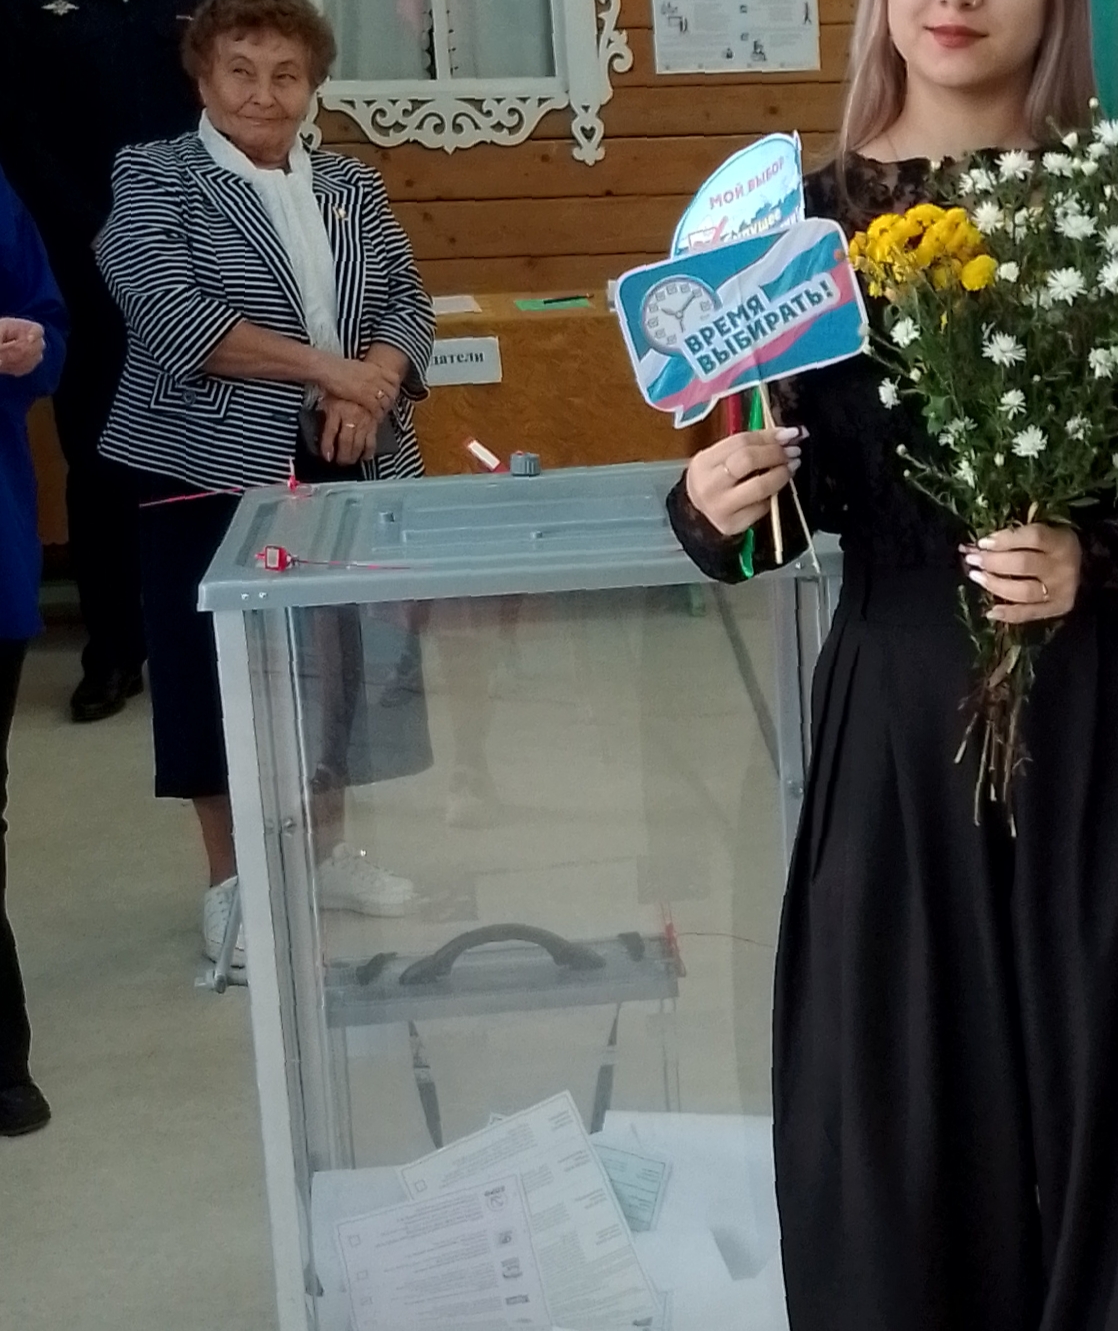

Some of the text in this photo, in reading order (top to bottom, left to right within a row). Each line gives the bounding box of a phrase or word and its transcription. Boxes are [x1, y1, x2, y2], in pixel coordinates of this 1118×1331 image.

[709, 155, 785, 210] МОЙ ВЫБОР
[684, 294, 765, 355] ВРЕМЯ
[696, 280, 834, 375] ВЫБИРАТЬ!
